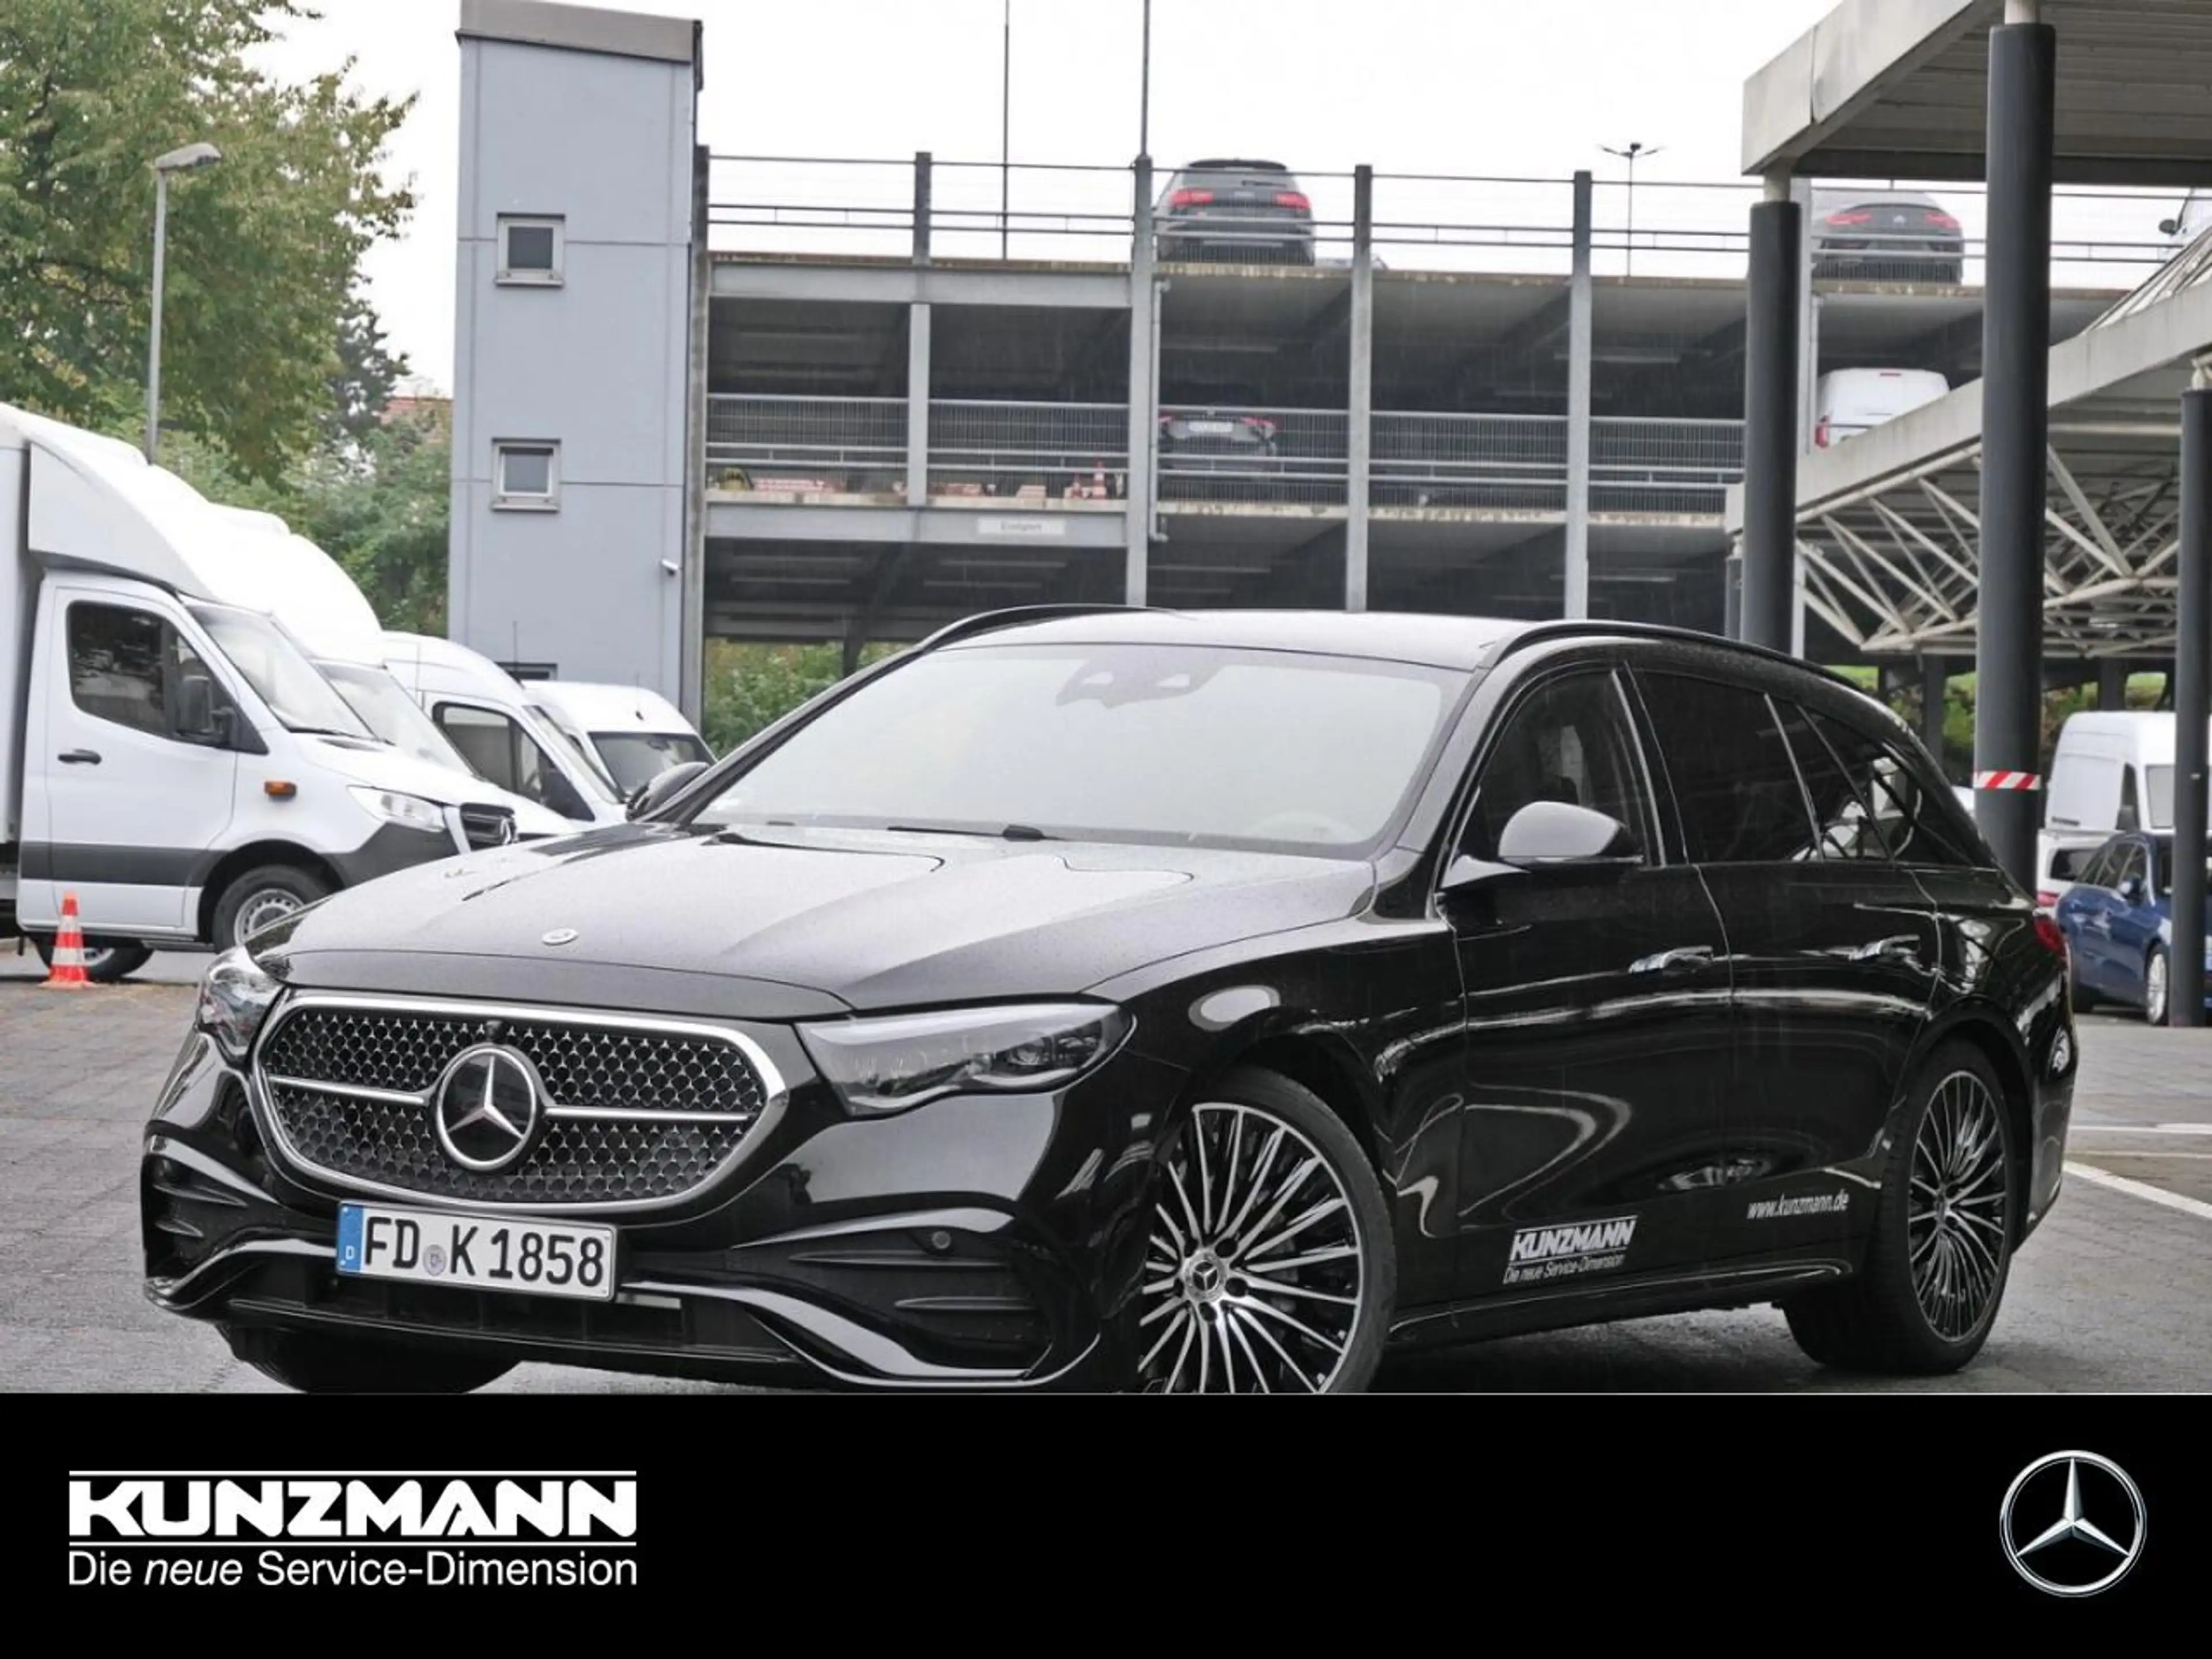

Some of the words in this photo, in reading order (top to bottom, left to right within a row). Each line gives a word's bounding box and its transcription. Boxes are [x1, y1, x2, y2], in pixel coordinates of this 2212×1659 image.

[1747, 1188, 1850, 1219] www.kunzmann.de
[365, 1217, 420, 1269] FD
[1509, 1219, 1637, 1262] KUNZMANN
